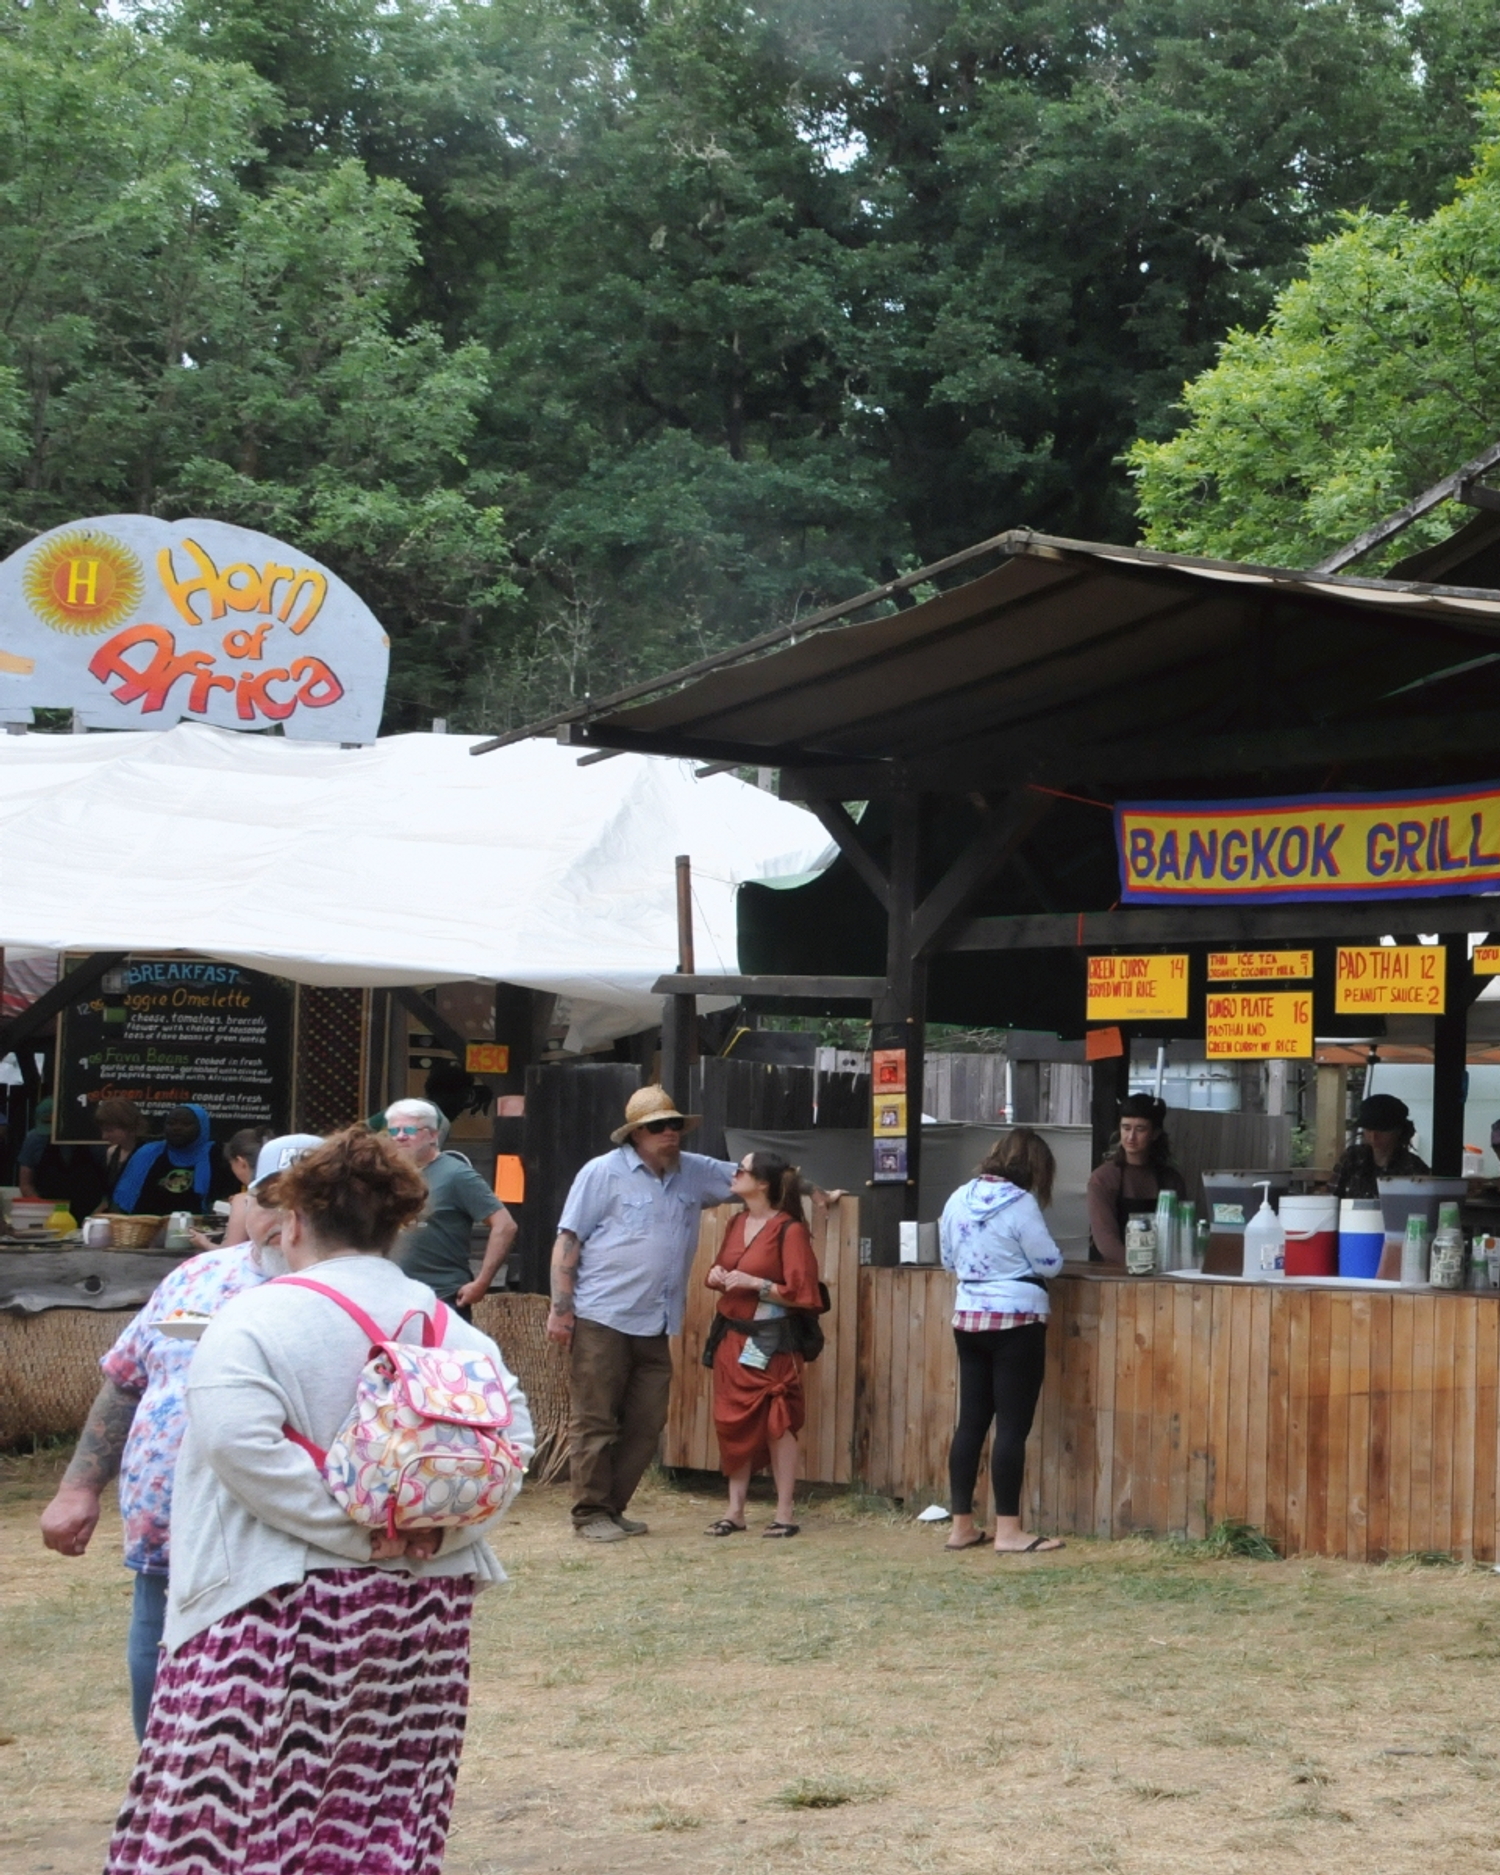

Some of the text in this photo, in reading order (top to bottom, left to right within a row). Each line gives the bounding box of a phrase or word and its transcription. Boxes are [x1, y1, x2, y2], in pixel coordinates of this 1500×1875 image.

[67, 559, 99, 605] H
[156, 538, 328, 635] Horn
[222, 623, 273, 660] of
[88, 623, 345, 720] Africa
[1129, 823, 1345, 881] BANGKOK
[1210, 953, 1309, 966] THAI ICE TEA 5
[1475, 948, 1499, 960] TOFU
[128, 963, 241, 985] BREAKFAST
[1089, 957, 1184, 979] GREEN CURRY 14
[1209, 968, 1238, 978] ORGANIC
[1277, 965, 1296, 976] MILK
[1338, 950, 1435, 980] PAD THAI 12
[123, 987, 252, 1012] eggie Omelette
[1112, 981, 1132, 998] WITH
[1136, 980, 1157, 998] RICE
[1344, 986, 1388, 1002] PEANUT
[1390, 986, 1424, 1003] SAUCE
[1208, 997, 1309, 1024] COMBO PLATE 16
[161, 1023, 183, 1031] with
[186, 1024, 215, 1032] choice
[1247, 1022, 1266, 1037] AND
[1208, 1041, 1232, 1053] GREEN
[1234, 1041, 1258, 1053] CURRY
[1275, 1039, 1298, 1052] RICE
[105, 1047, 263, 1067] Fava Beans cooked in fresh
[100, 1083, 263, 1103] Green Lentils cooked in fresh
